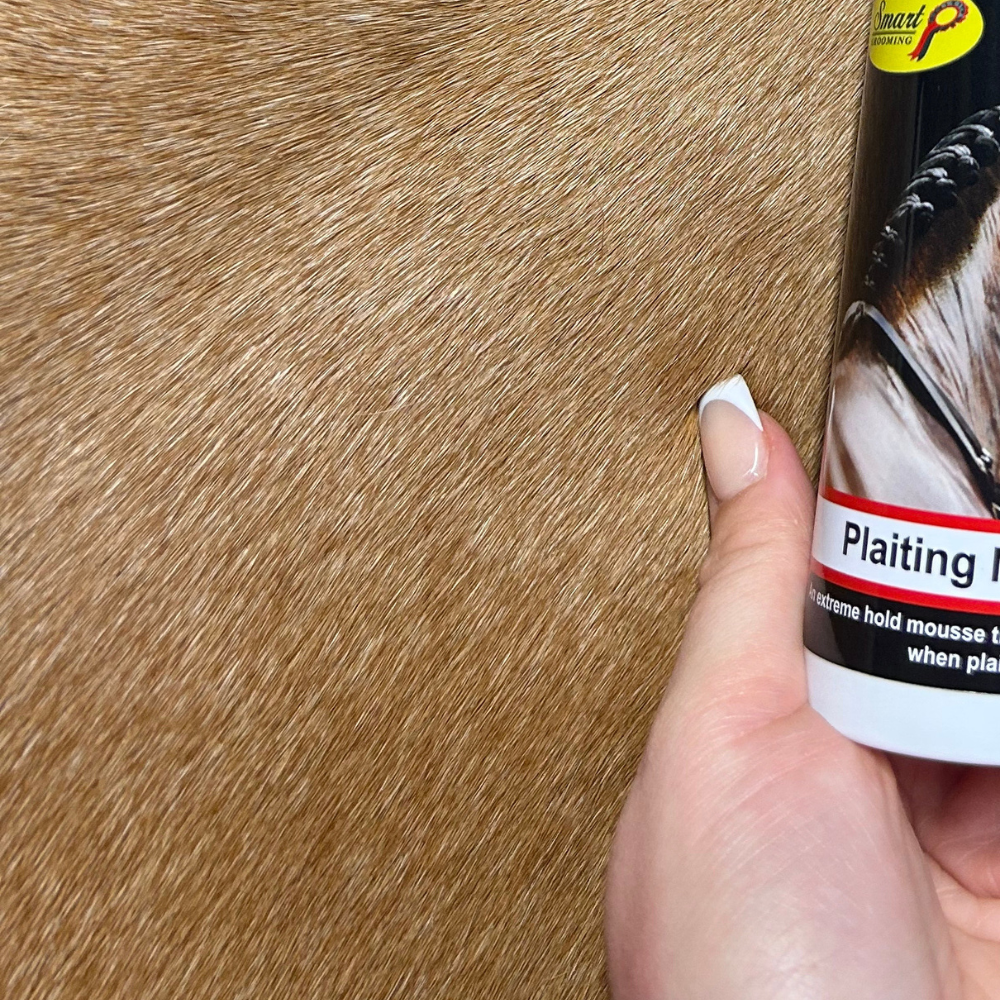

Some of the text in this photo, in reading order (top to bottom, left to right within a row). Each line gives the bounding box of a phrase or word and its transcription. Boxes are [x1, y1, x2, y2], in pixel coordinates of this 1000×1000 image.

[874, 0, 926, 30] Smart
[842, 521, 976, 588] Plaiting
[816, 592, 860, 620] extreme
[863, 604, 901, 631] hold
[906, 619, 985, 643] mousse
[908, 645, 961, 669] when
